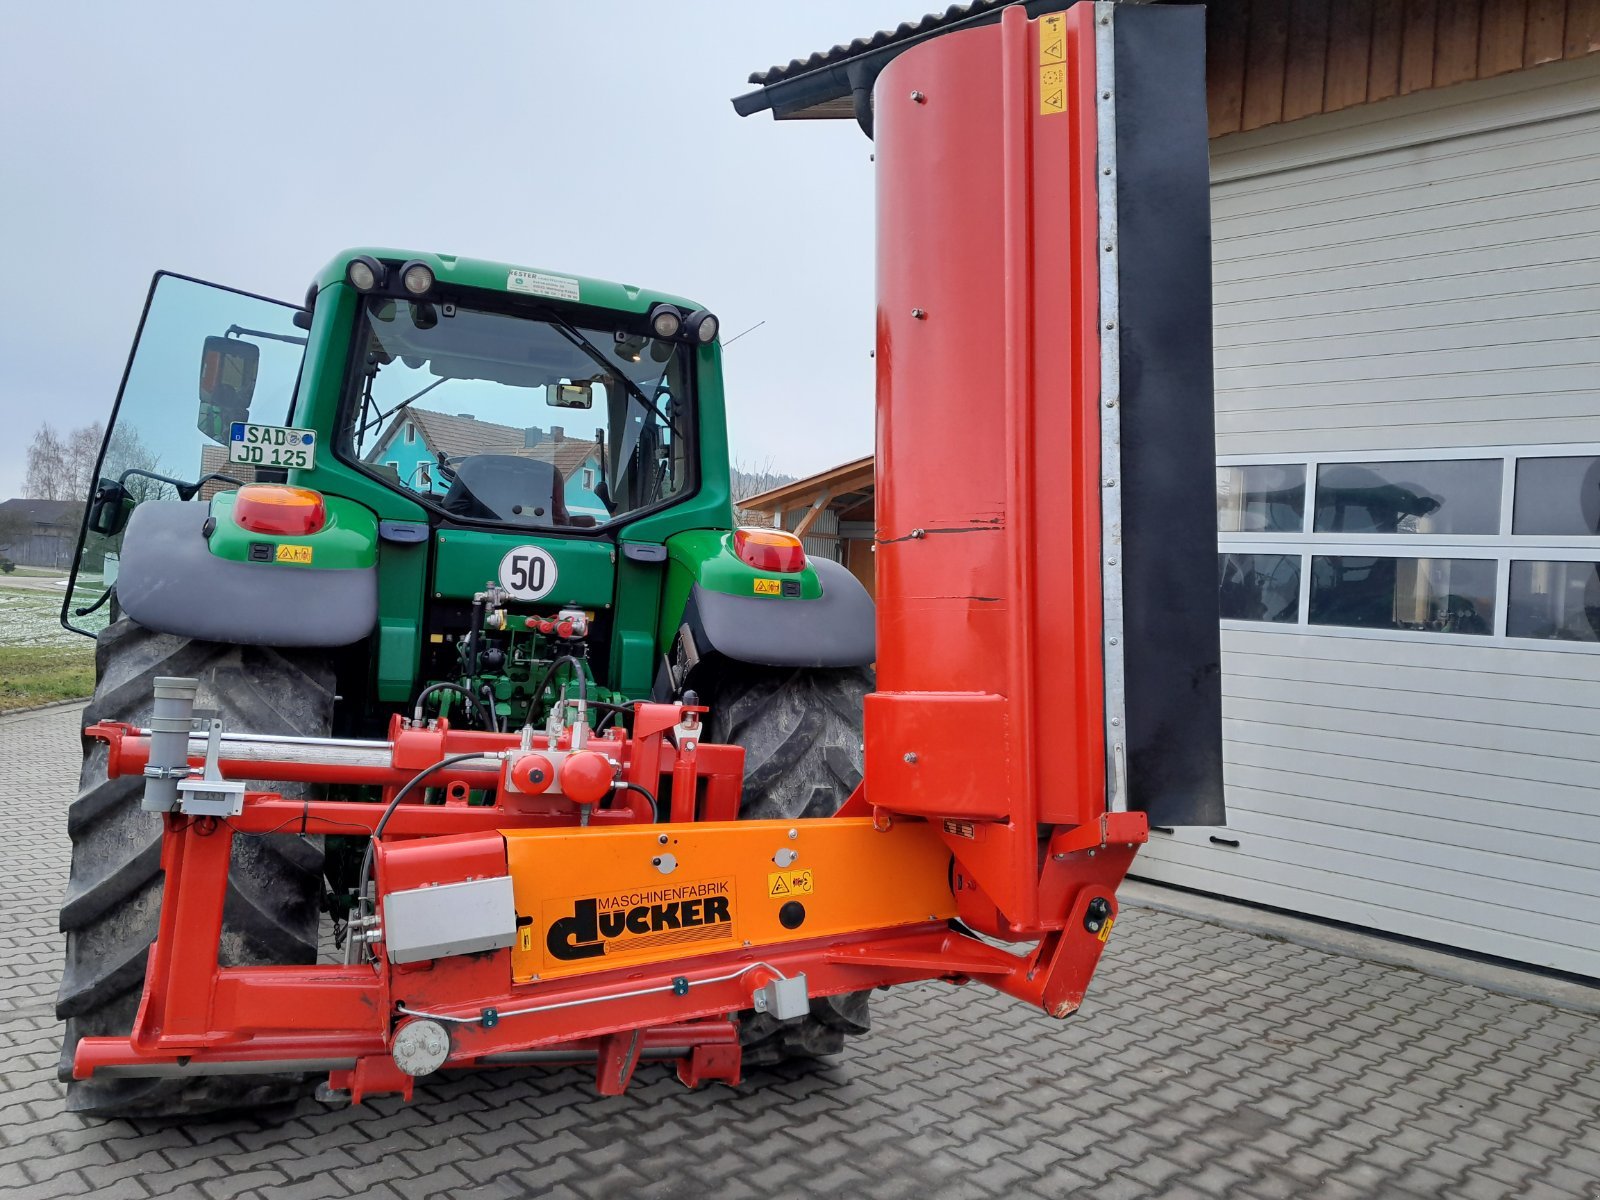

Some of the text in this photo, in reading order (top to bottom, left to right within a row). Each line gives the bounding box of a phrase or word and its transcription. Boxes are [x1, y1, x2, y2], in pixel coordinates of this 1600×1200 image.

[247, 427, 286, 446] SAD
[238, 445, 306, 466] JD 125
[510, 555, 546, 592] 50
[599, 881, 729, 910] MASCHINENFABRIK
